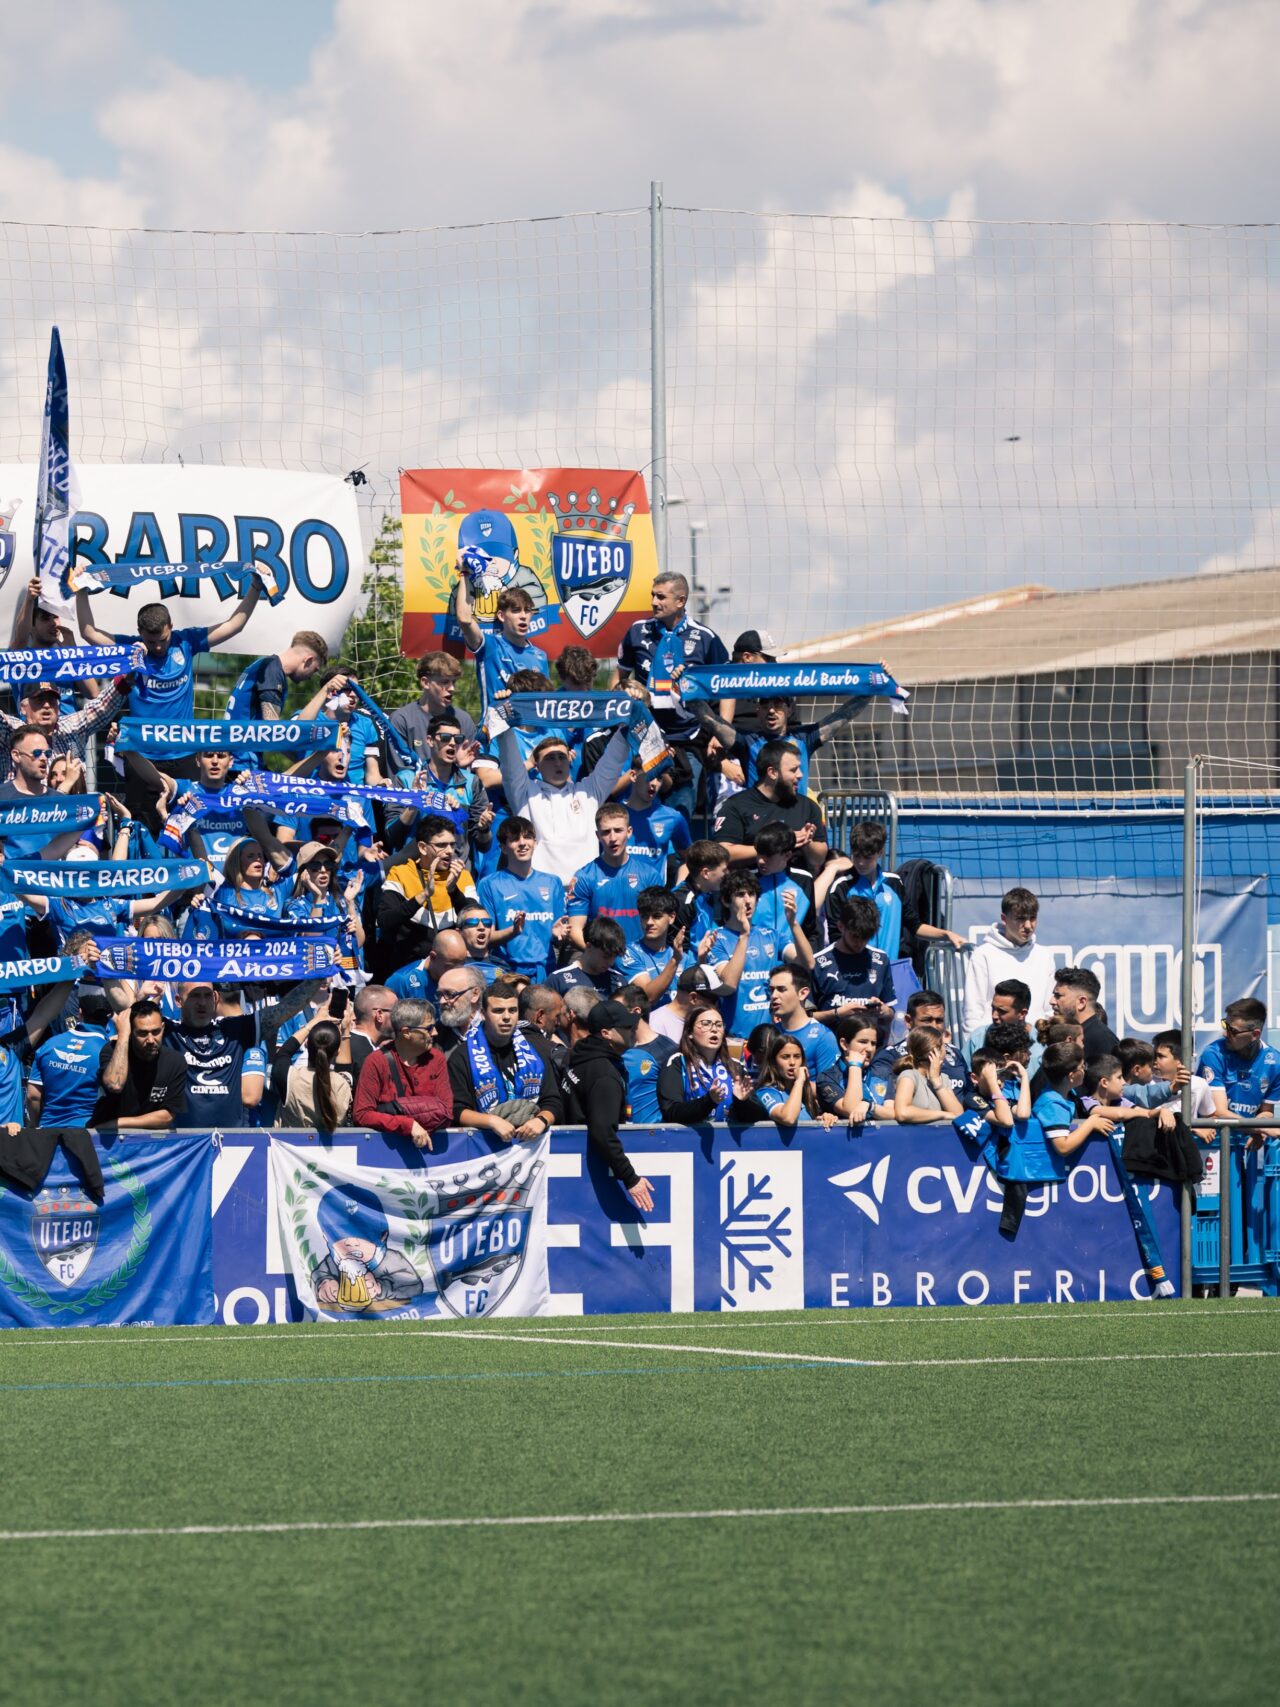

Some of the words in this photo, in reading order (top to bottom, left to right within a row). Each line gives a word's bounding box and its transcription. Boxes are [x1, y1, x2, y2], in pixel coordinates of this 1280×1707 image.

[69, 511, 349, 604] BARBO
[560, 541, 626, 581] UTEBO
[129, 563, 188, 578] UTEBO
[199, 562, 225, 574] FC
[579, 604, 599, 627] FC
[37, 648, 54, 661] FC
[57, 647, 84, 659] 1924
[96, 646, 125, 657] 2024
[55, 662, 121, 678] Años
[710, 671, 790, 693] Guardianes
[793, 671, 817, 686] del
[820, 670, 859, 686] Barbo
[535, 700, 593, 719] UTEBO
[604, 699, 631, 719] FC
[141, 724, 222, 743] FRENTE
[229, 724, 300, 743] BARBO
[5, 807, 29, 825] del
[30, 804, 68, 823] Barbo
[13, 869, 91, 888] FRENTE
[97, 867, 169, 887] BARBO
[143, 942, 192, 957] UTEBO
[196, 942, 215, 957] FC
[219, 942, 250, 957] 1924
[265, 941, 297, 956] 2024
[147, 959, 202, 978] 100
[217, 961, 294, 977] Años
[40, 1220, 93, 1249] UTEBO
[439, 1217, 522, 1264] UTEBO
[59, 1264, 75, 1279] FC
[464, 1289, 489, 1314] FC
